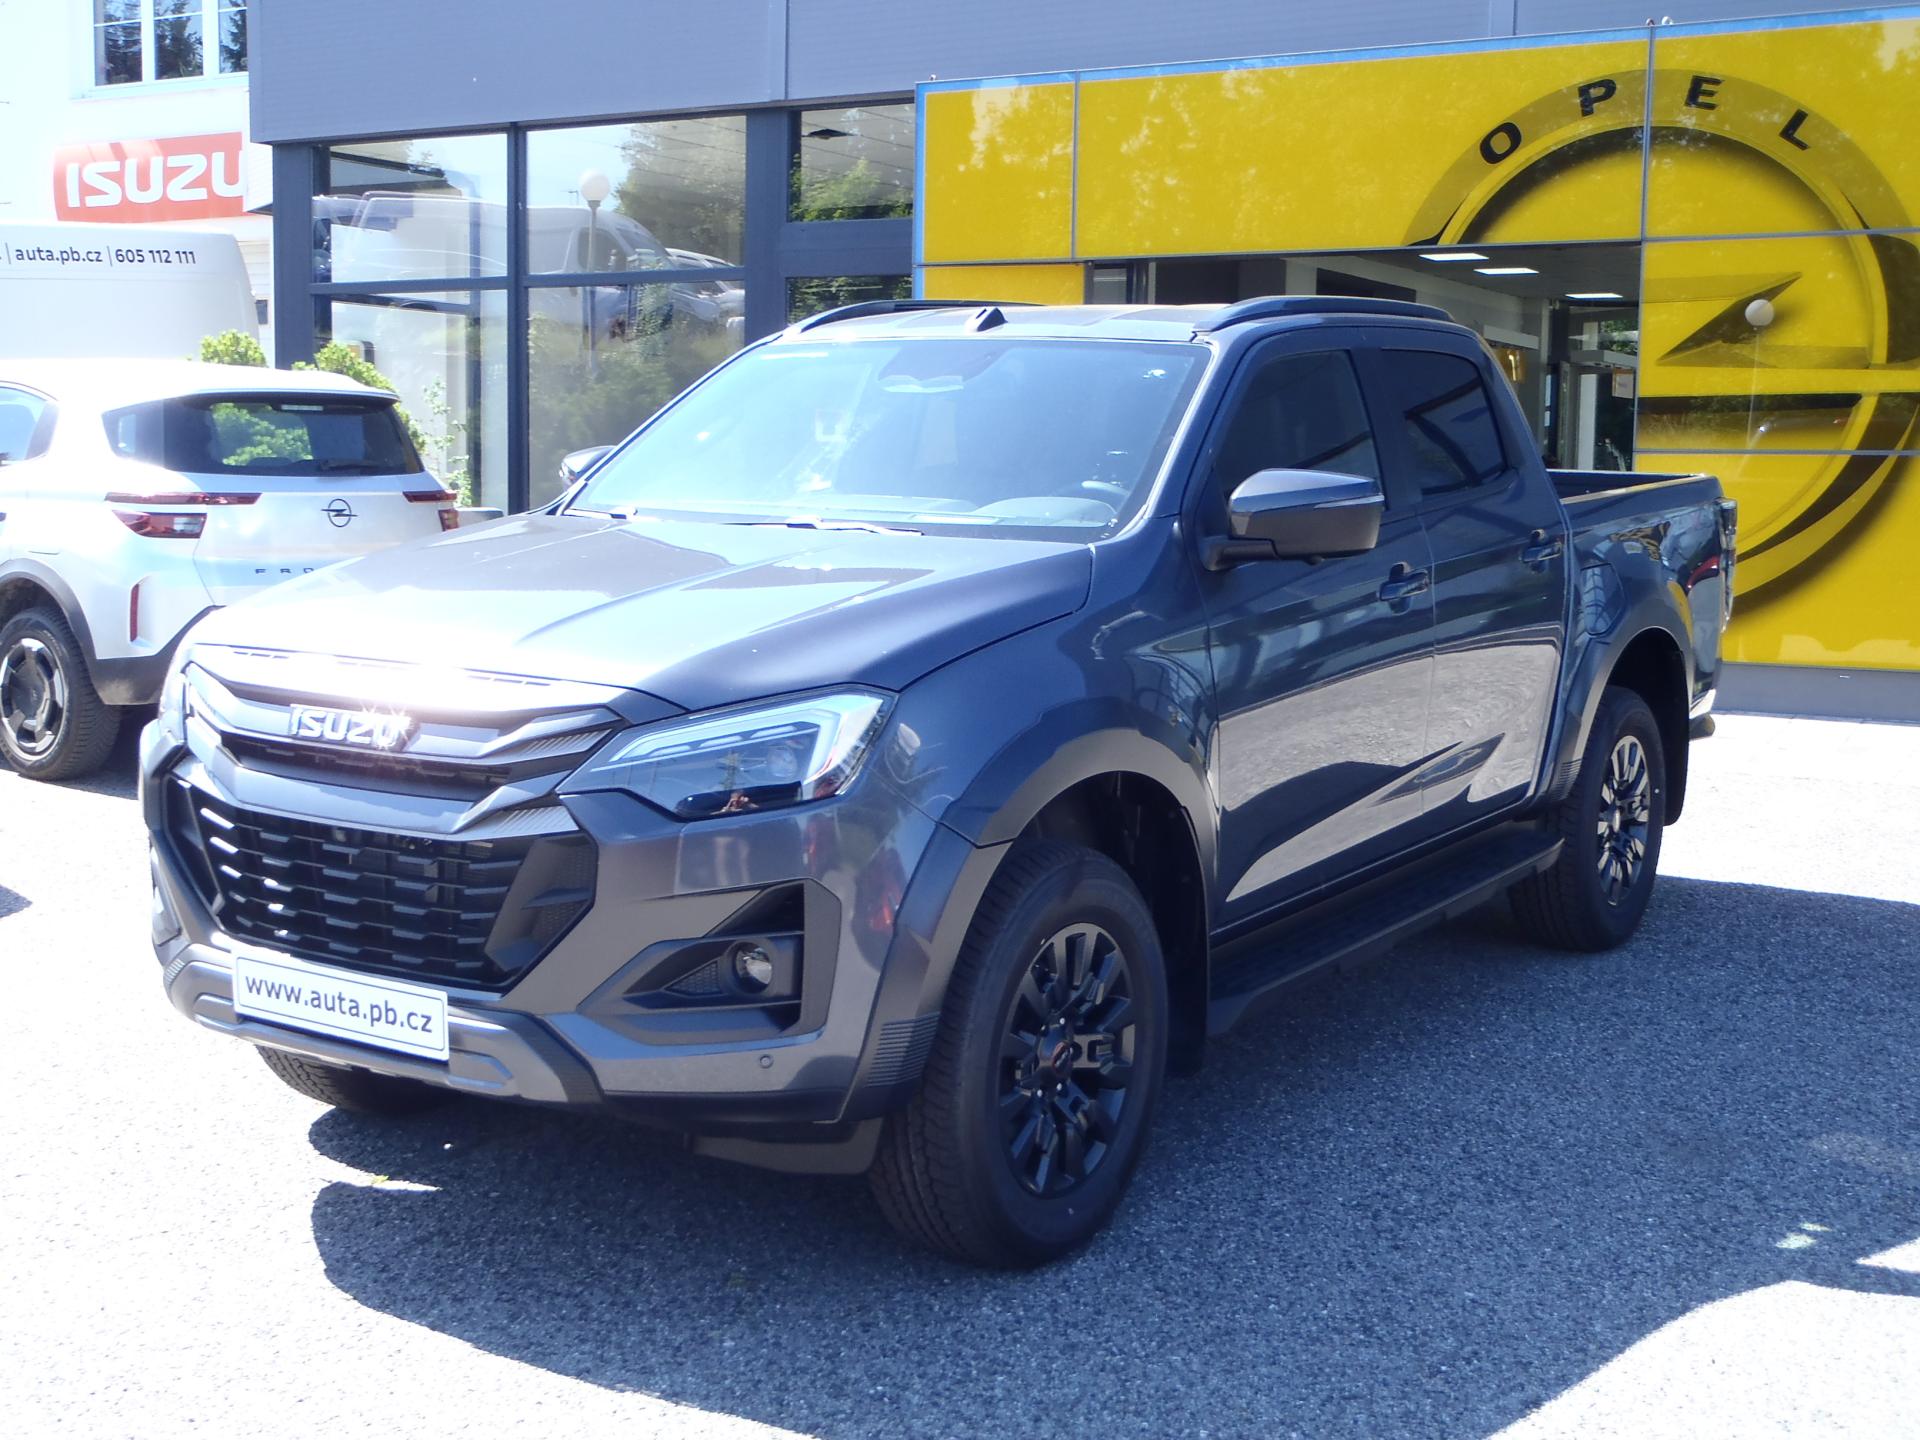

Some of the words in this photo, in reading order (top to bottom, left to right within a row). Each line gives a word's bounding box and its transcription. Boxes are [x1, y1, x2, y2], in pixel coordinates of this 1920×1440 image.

[1480, 74, 1809, 164] OPEL
[66, 151, 243, 208] ISUZU
[15, 246, 104, 265] auta.pb.cz
[115, 248, 146, 263] 605
[149, 249, 172, 264] 112
[175, 250, 197, 265] 111
[289, 705, 407, 748] ISUZU
[245, 975, 433, 1034] www.auta.pb.cz
